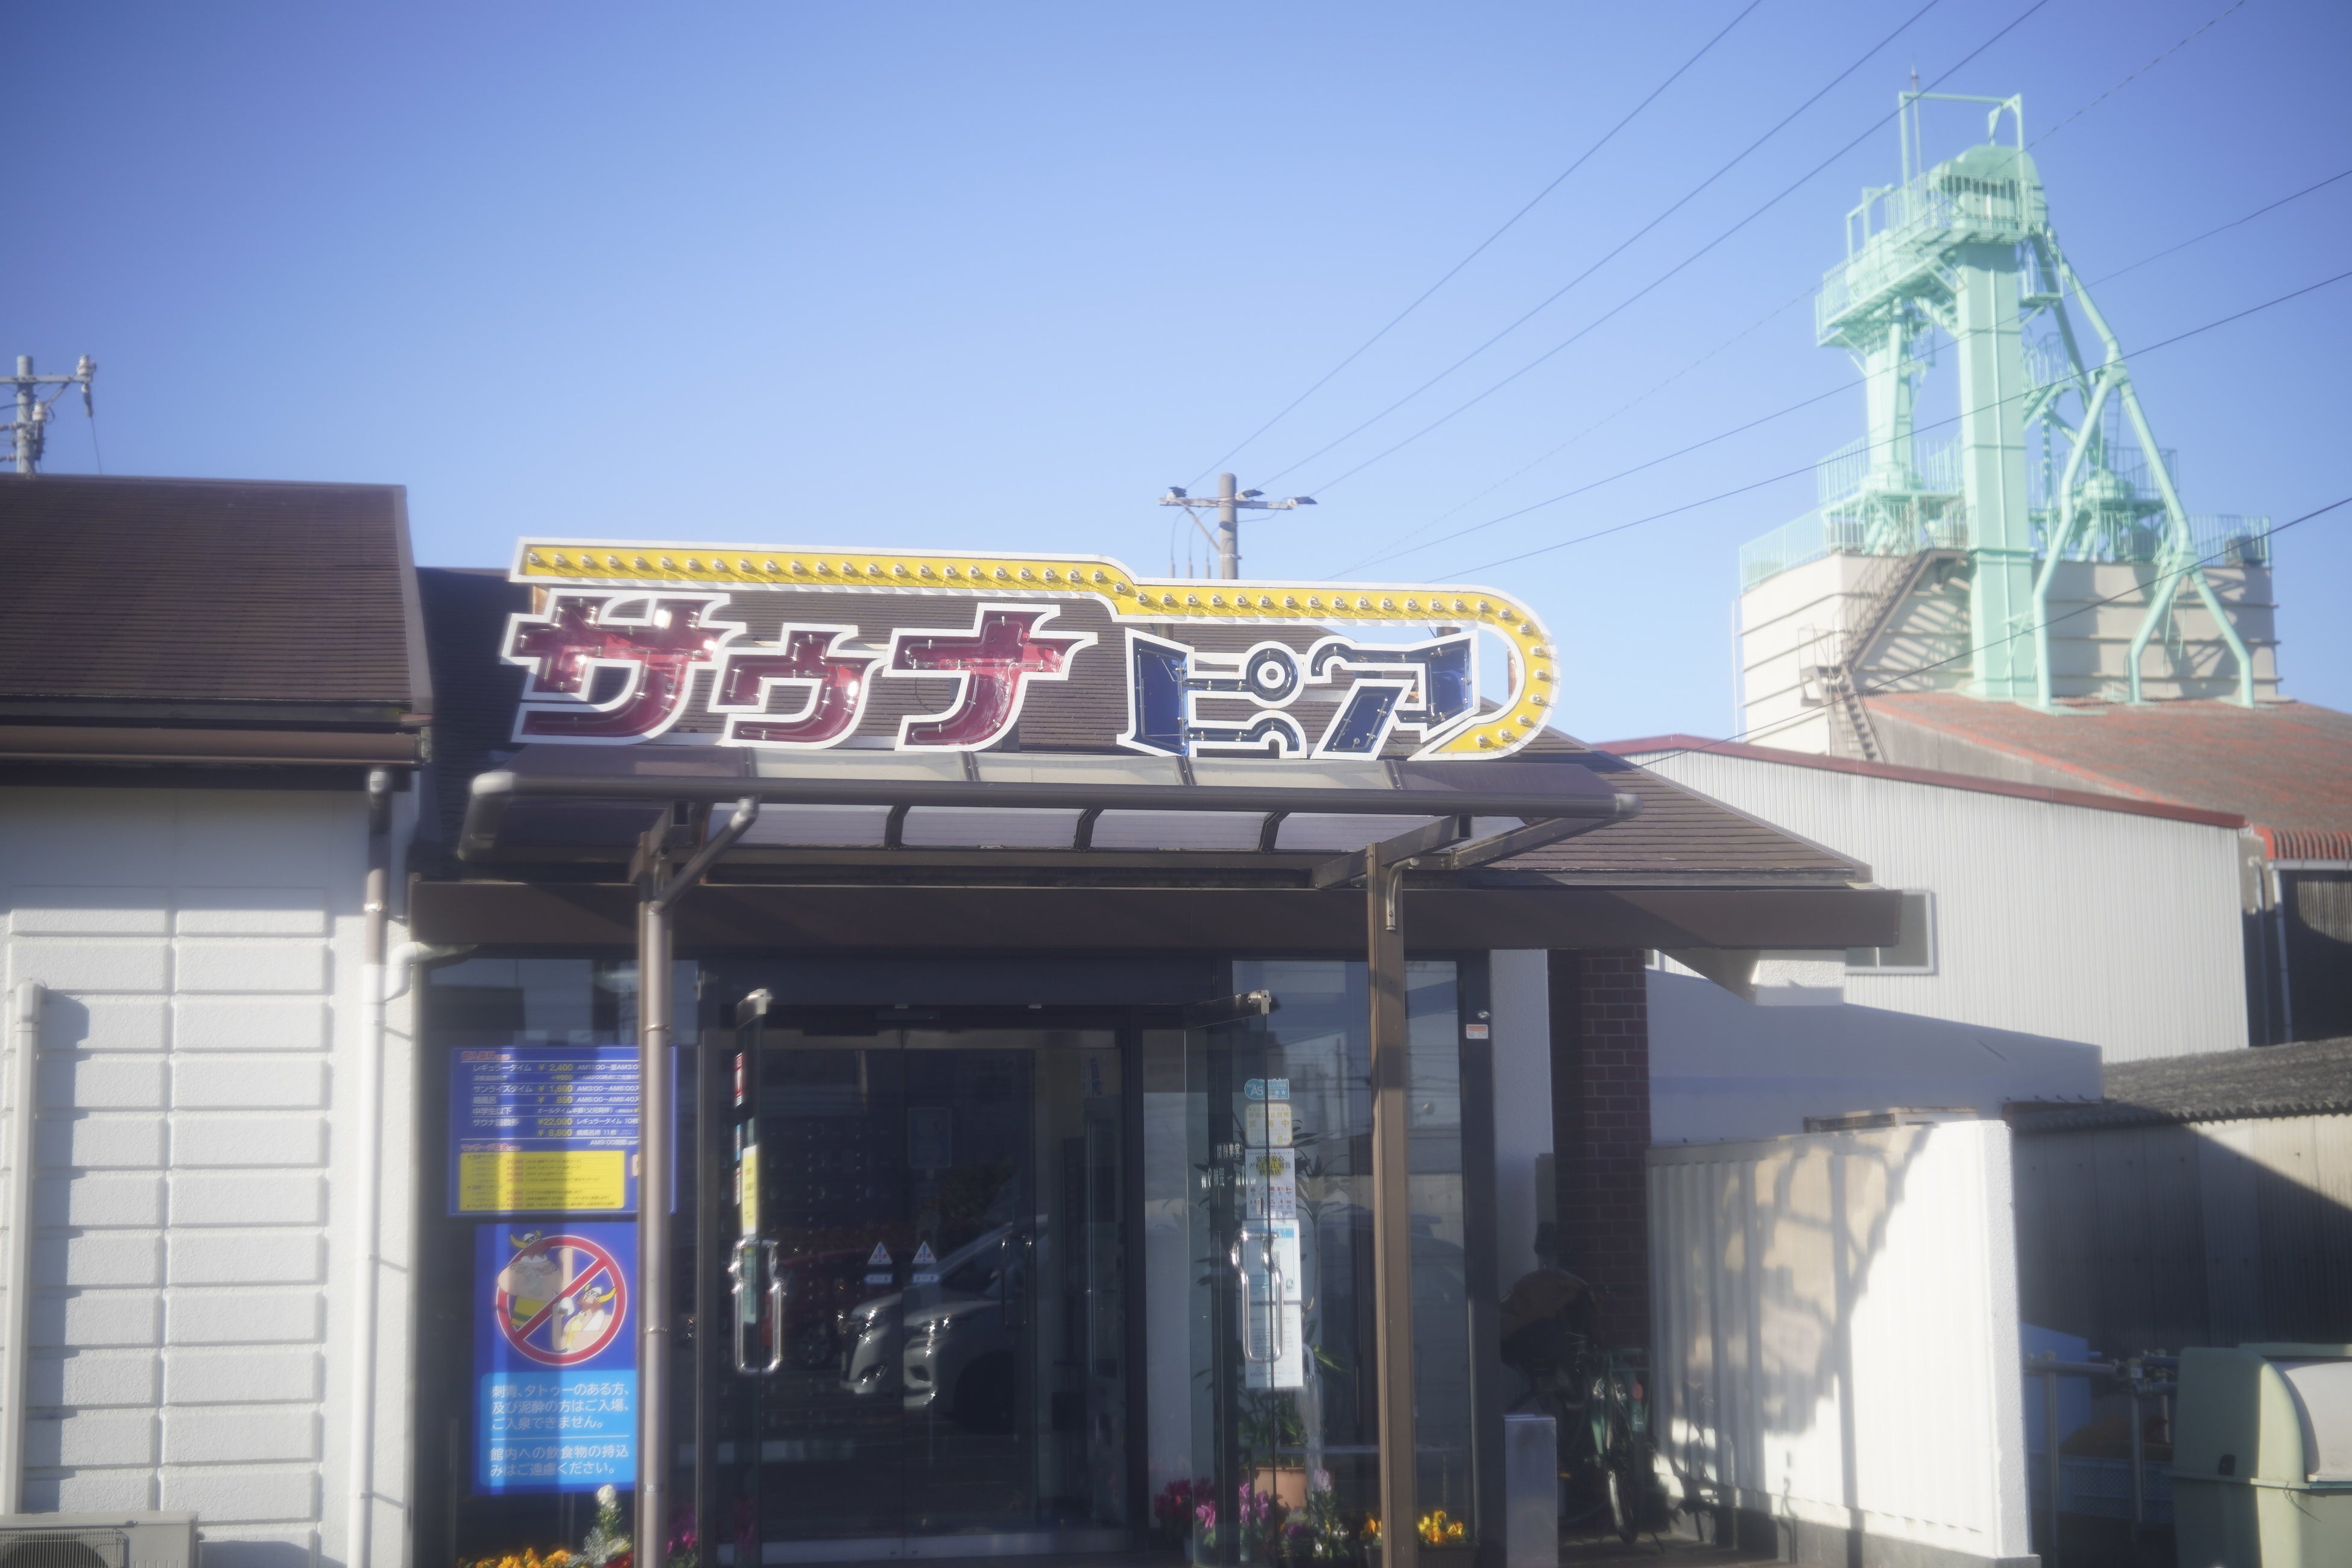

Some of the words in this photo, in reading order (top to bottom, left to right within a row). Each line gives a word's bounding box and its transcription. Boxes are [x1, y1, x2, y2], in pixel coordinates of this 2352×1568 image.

[473, 1107, 511, 1115] 中学生以下
[492, 1415, 602, 1430] ご入泉できません。
[490, 1462, 615, 1477] みはご遠慮ください。
